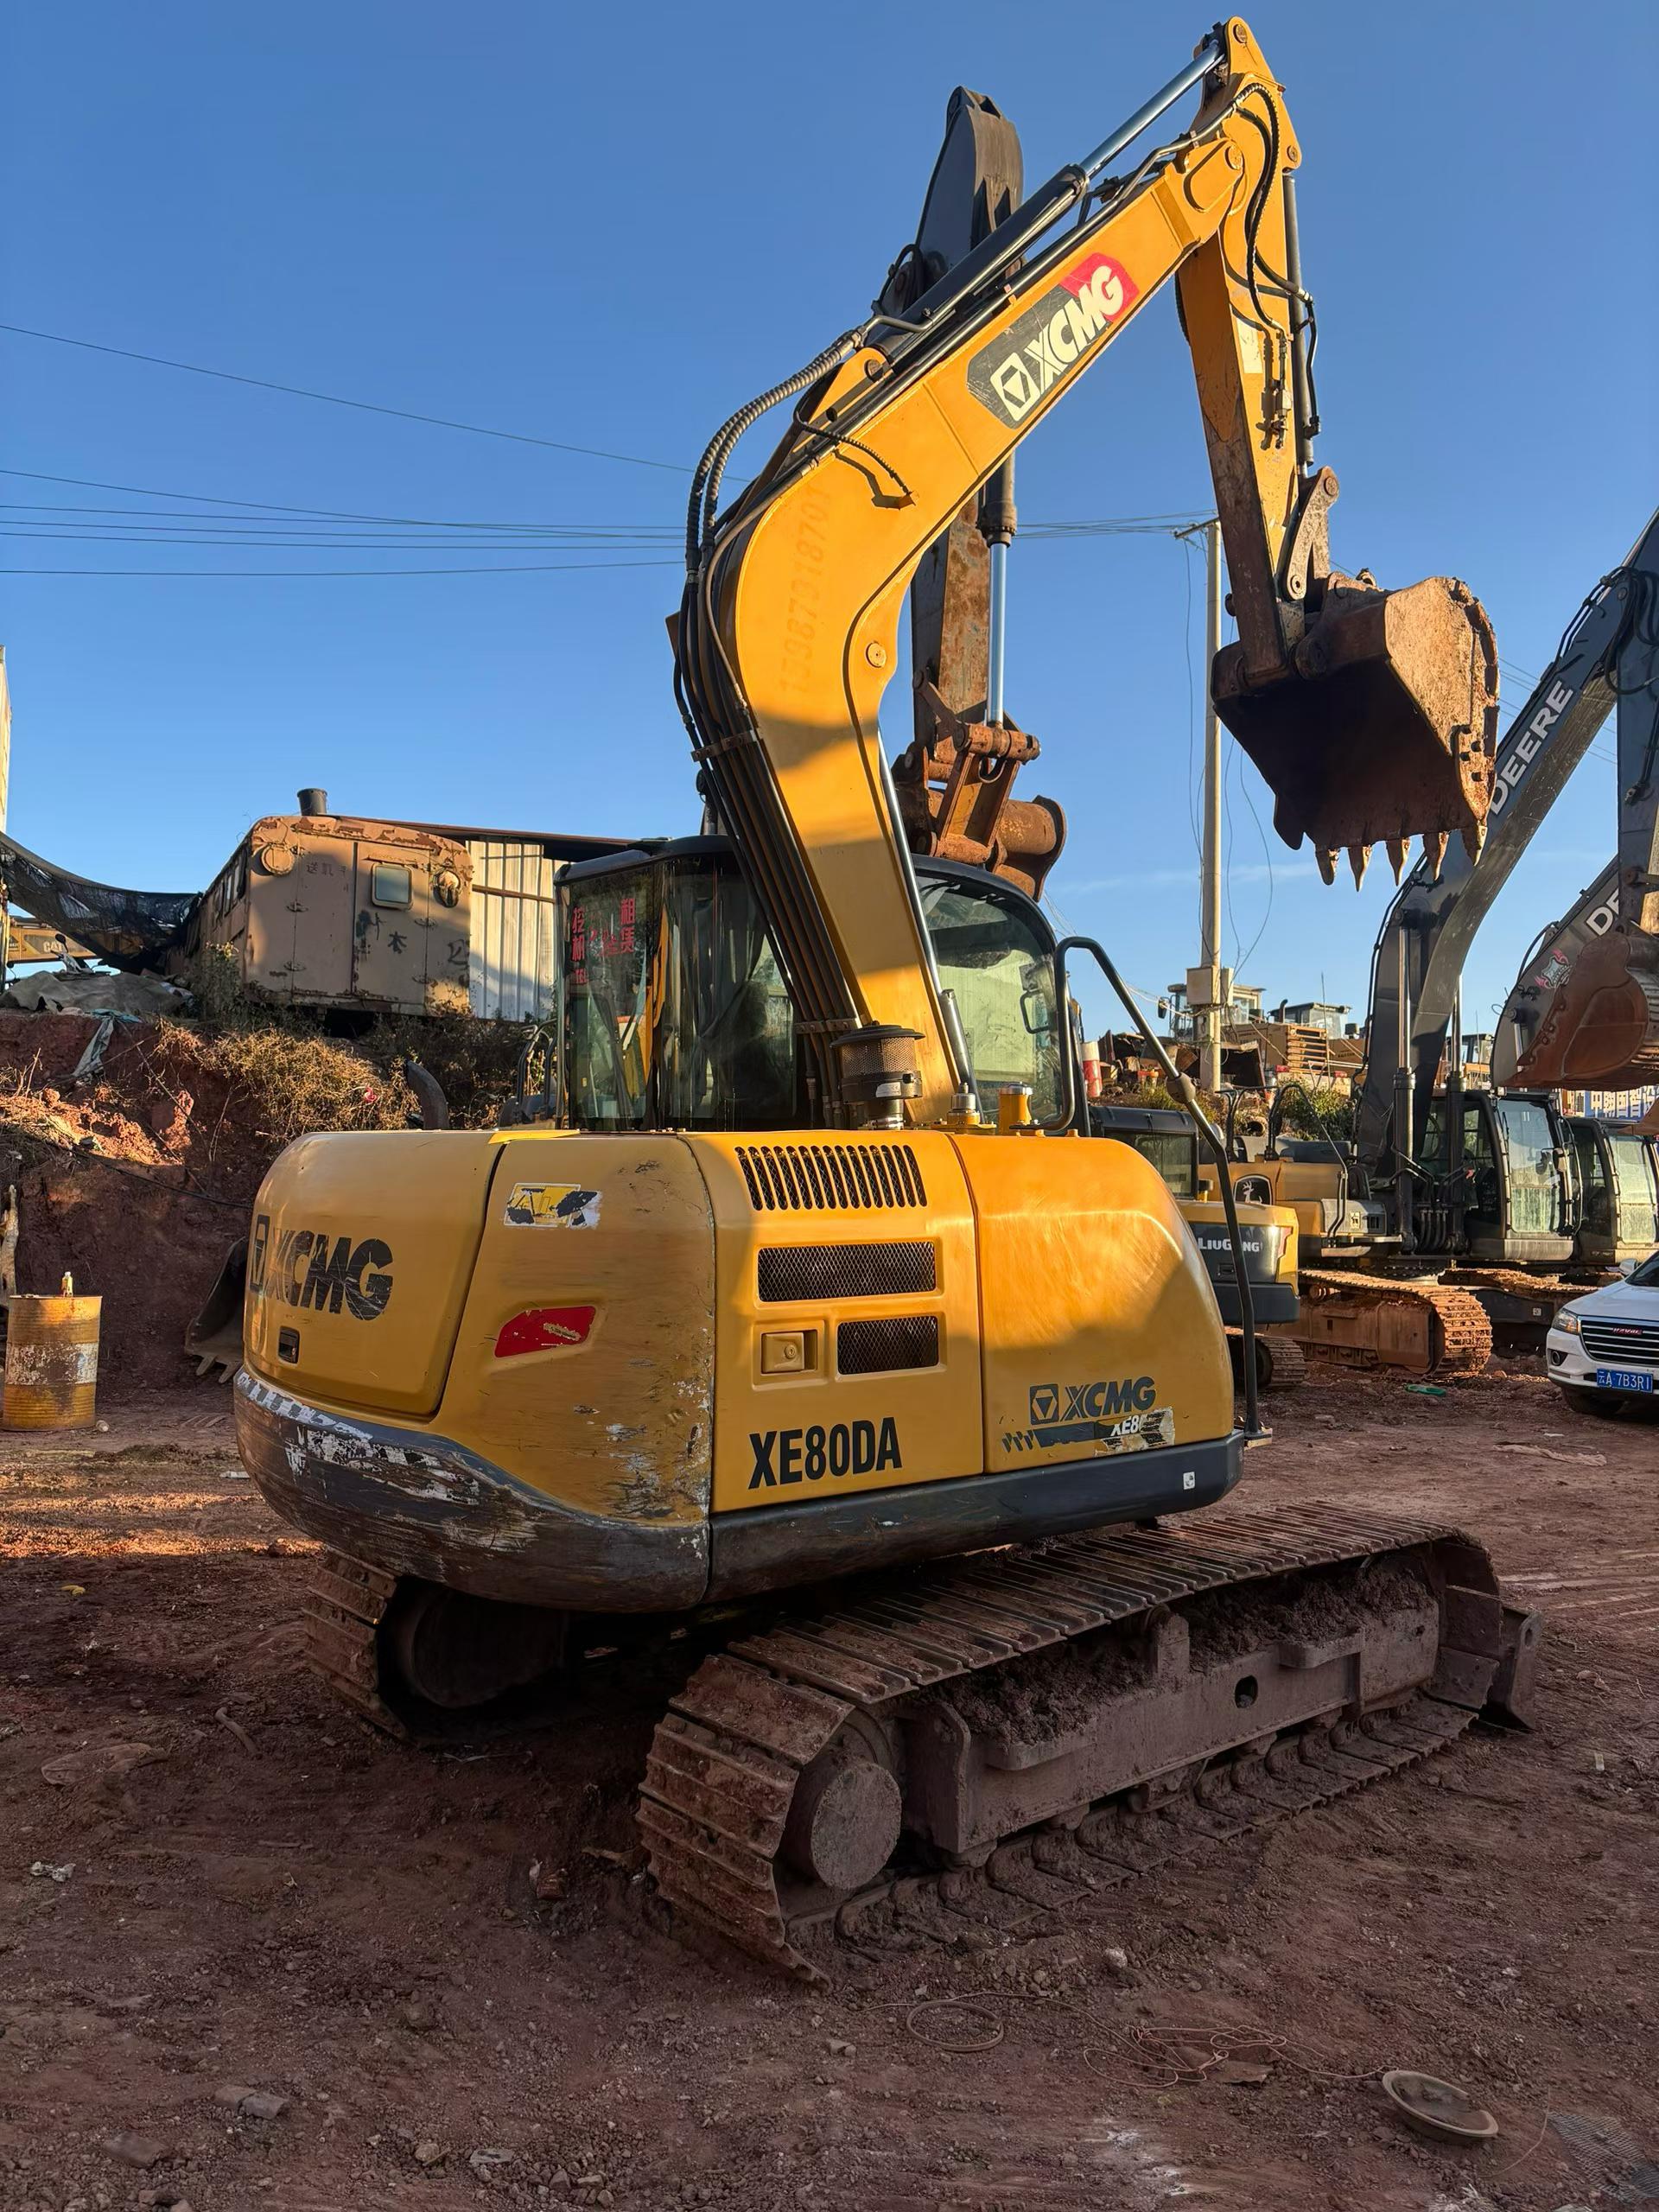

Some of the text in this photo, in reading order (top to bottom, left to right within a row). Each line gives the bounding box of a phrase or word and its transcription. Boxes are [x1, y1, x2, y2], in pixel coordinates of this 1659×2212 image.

[1023, 264, 1124, 396] XCMG
[1490, 679, 1573, 816] DEERE
[1060, 1376, 1157, 1421] XCMG
[748, 1416, 902, 1490] XE80DA
